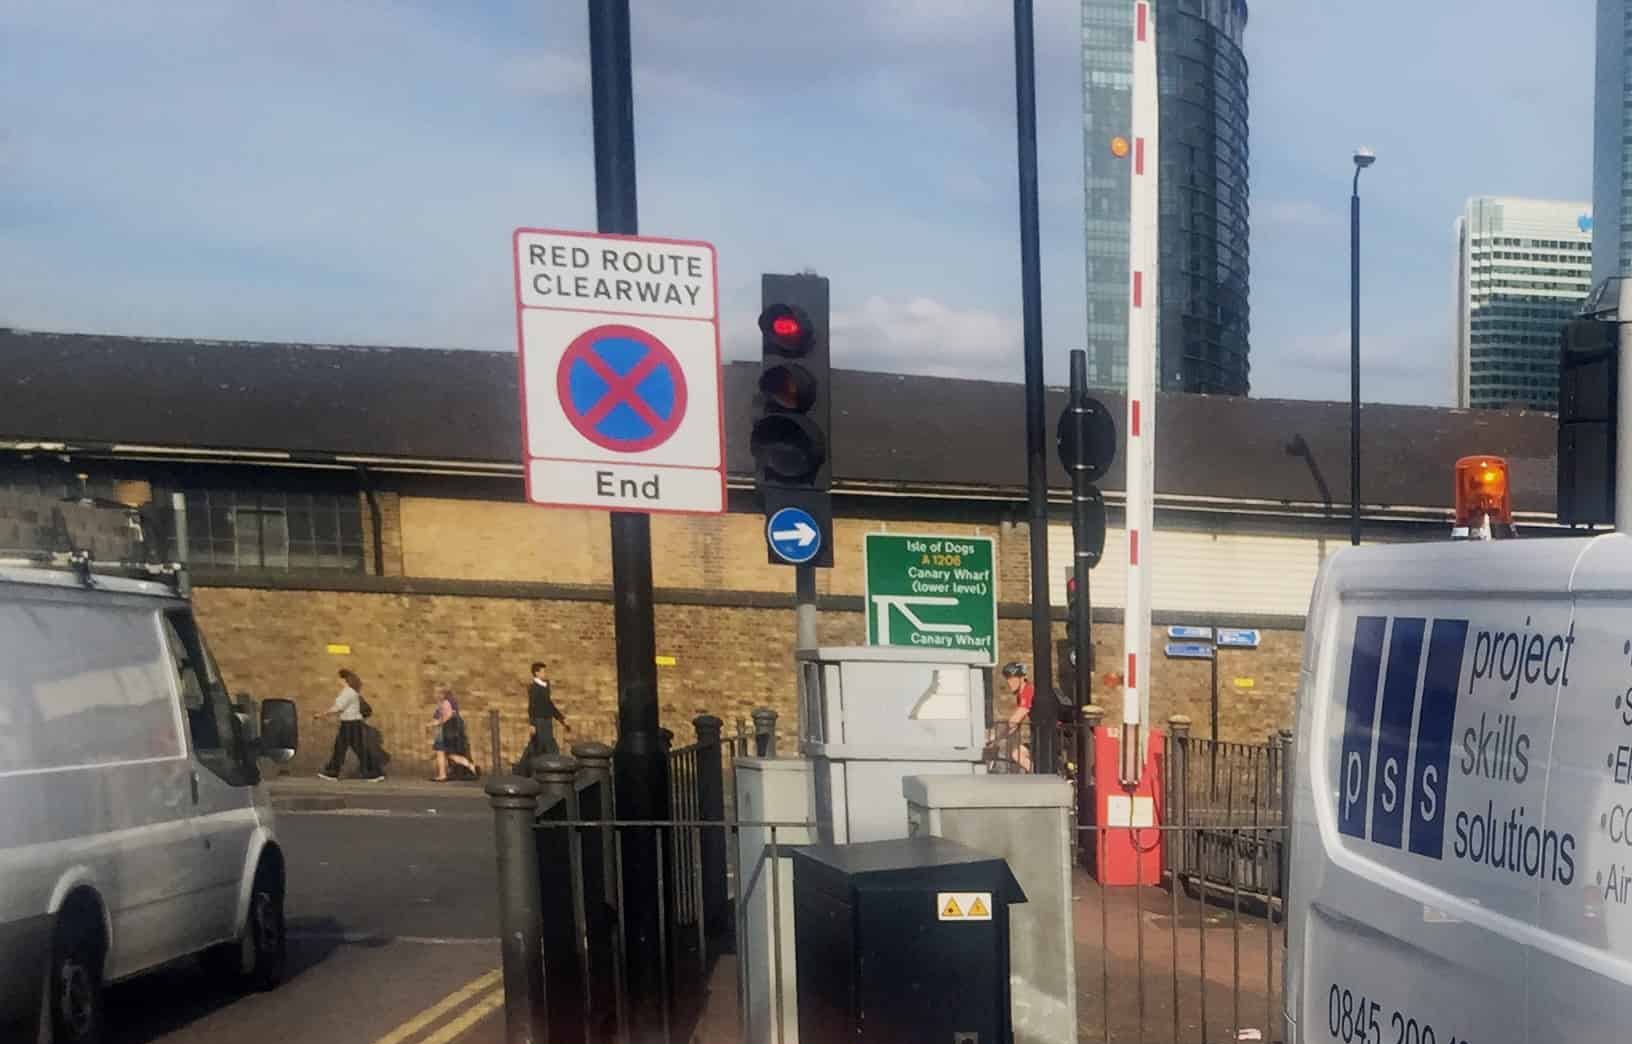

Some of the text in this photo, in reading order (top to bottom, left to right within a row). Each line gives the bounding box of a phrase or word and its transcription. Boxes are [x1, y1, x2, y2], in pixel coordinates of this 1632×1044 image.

[529, 244, 703, 278] RED ROUTE
[533, 273, 701, 306] CLEARWAY
[596, 471, 660, 499] End
[907, 540, 975, 556] Isle of Dogs
[908, 567, 990, 582] Canary Wharf
[911, 579, 987, 596] (lower level)
[911, 631, 991, 648] Canary Wharf
[1469, 617, 1575, 701] project
[1461, 713, 1530, 785] skills
[1454, 800, 1576, 886] solutions
[1604, 864, 1631, 903] Air
